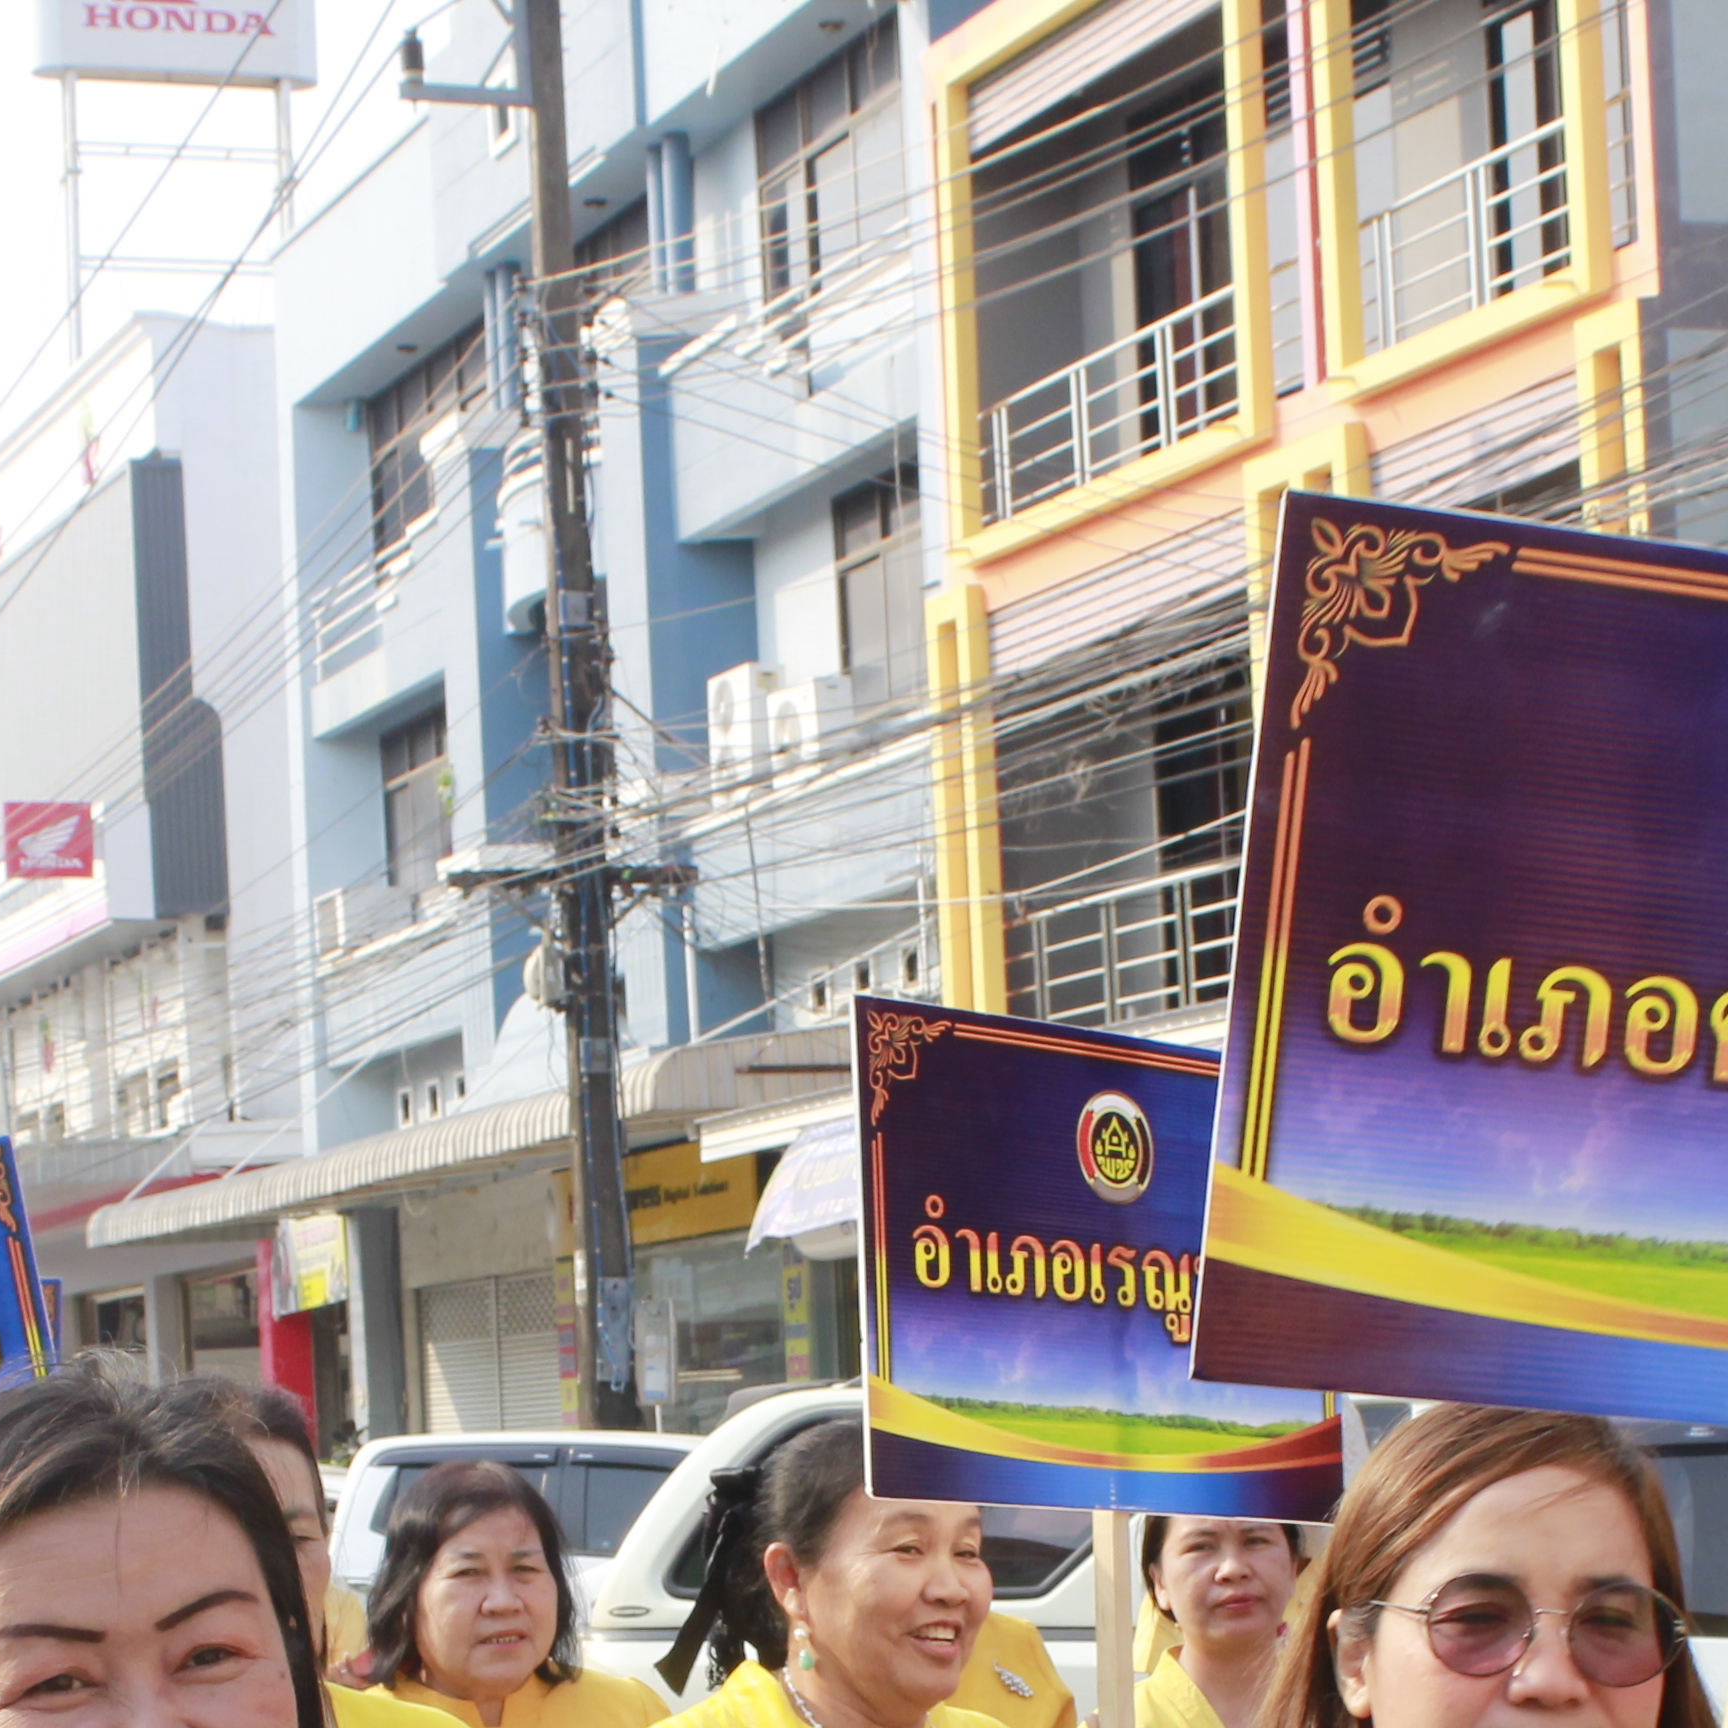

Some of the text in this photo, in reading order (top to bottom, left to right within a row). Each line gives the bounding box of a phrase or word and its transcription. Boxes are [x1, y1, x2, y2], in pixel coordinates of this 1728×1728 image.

[85, 4, 276, 37] HONDA
[912, 1195, 1198, 1343] อำเภอเรณู
